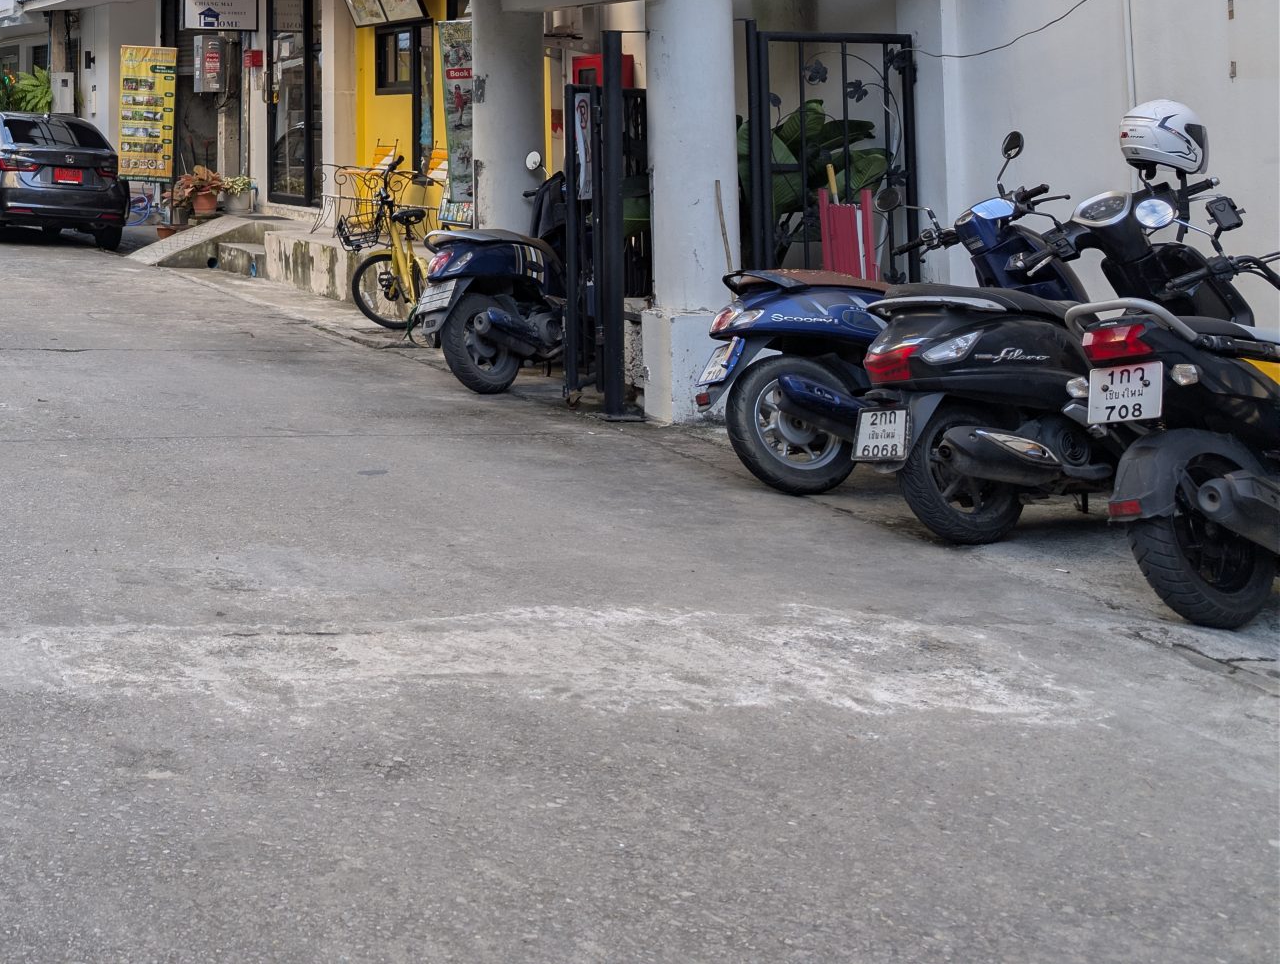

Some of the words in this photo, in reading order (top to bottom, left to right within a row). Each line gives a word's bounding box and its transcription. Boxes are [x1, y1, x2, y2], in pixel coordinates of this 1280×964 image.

[1105, 386, 1144, 401] เชียงใหม่
[1105, 403, 1143, 421] 708
[861, 443, 898, 457] 6068
